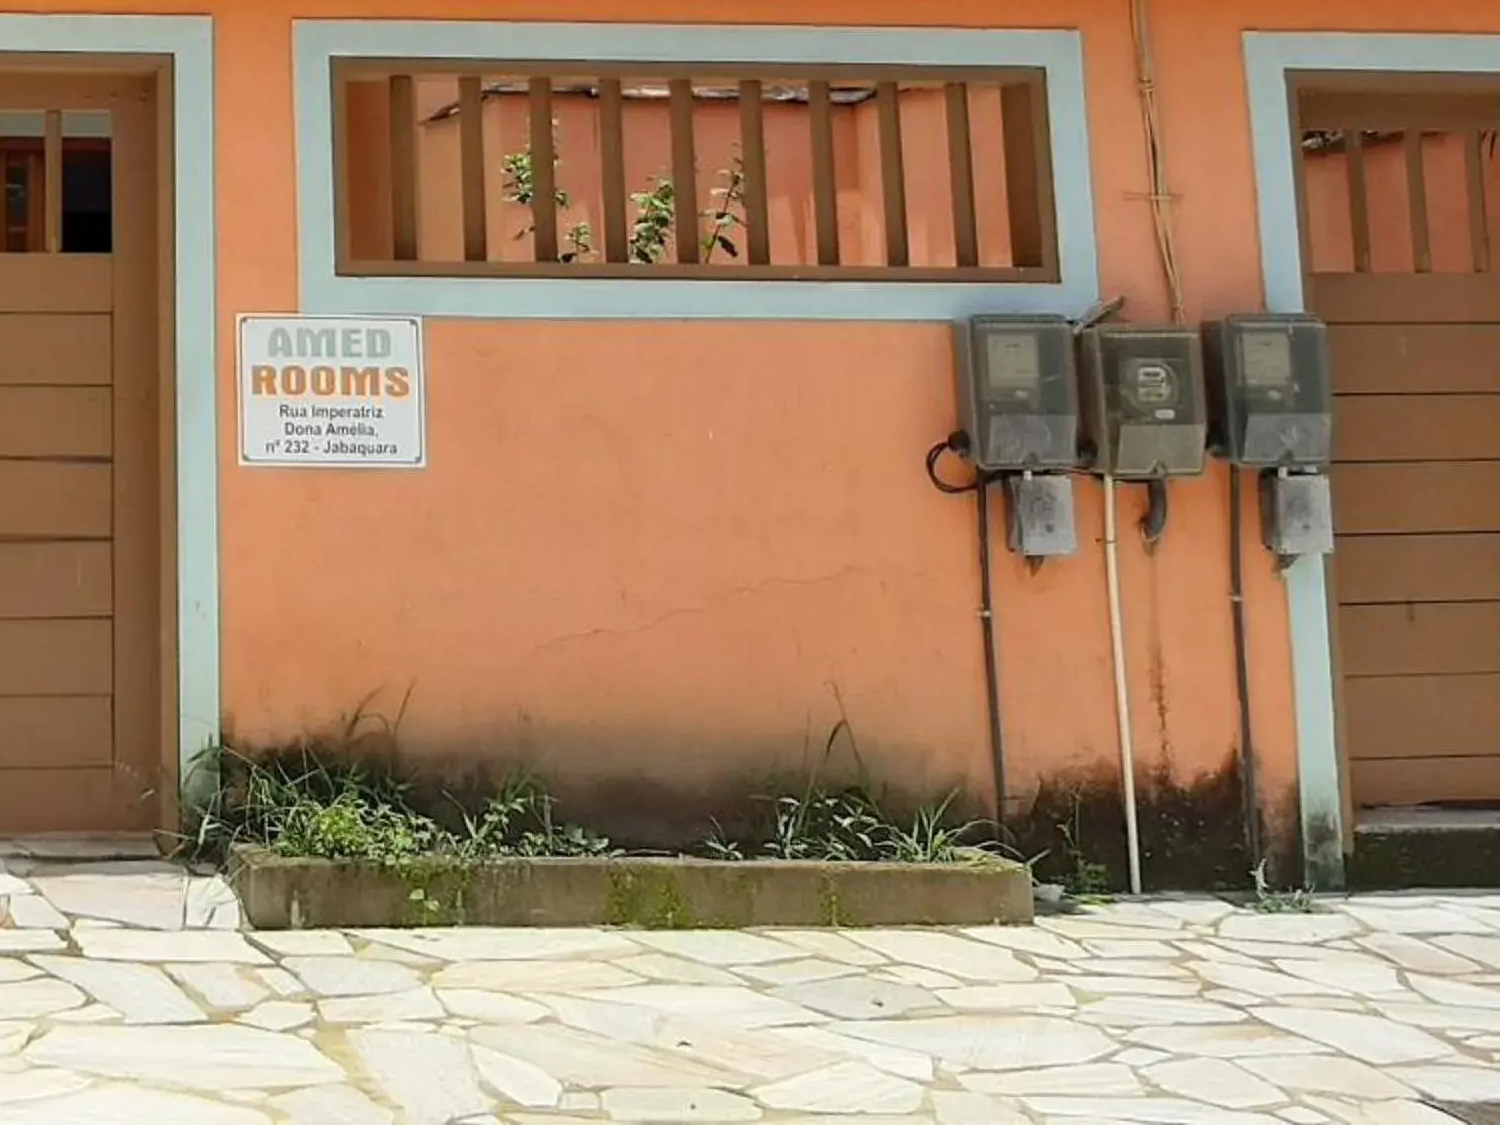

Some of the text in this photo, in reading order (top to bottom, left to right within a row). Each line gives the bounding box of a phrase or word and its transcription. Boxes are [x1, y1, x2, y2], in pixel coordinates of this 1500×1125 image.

[268, 327, 391, 358] AMED
[251, 364, 410, 397] ROOMS
[279, 404, 384, 421] Rua Imperatriz
[284, 422, 322, 436] Dona
[284, 440, 310, 454] 232
[323, 440, 398, 457] Jabaquara
